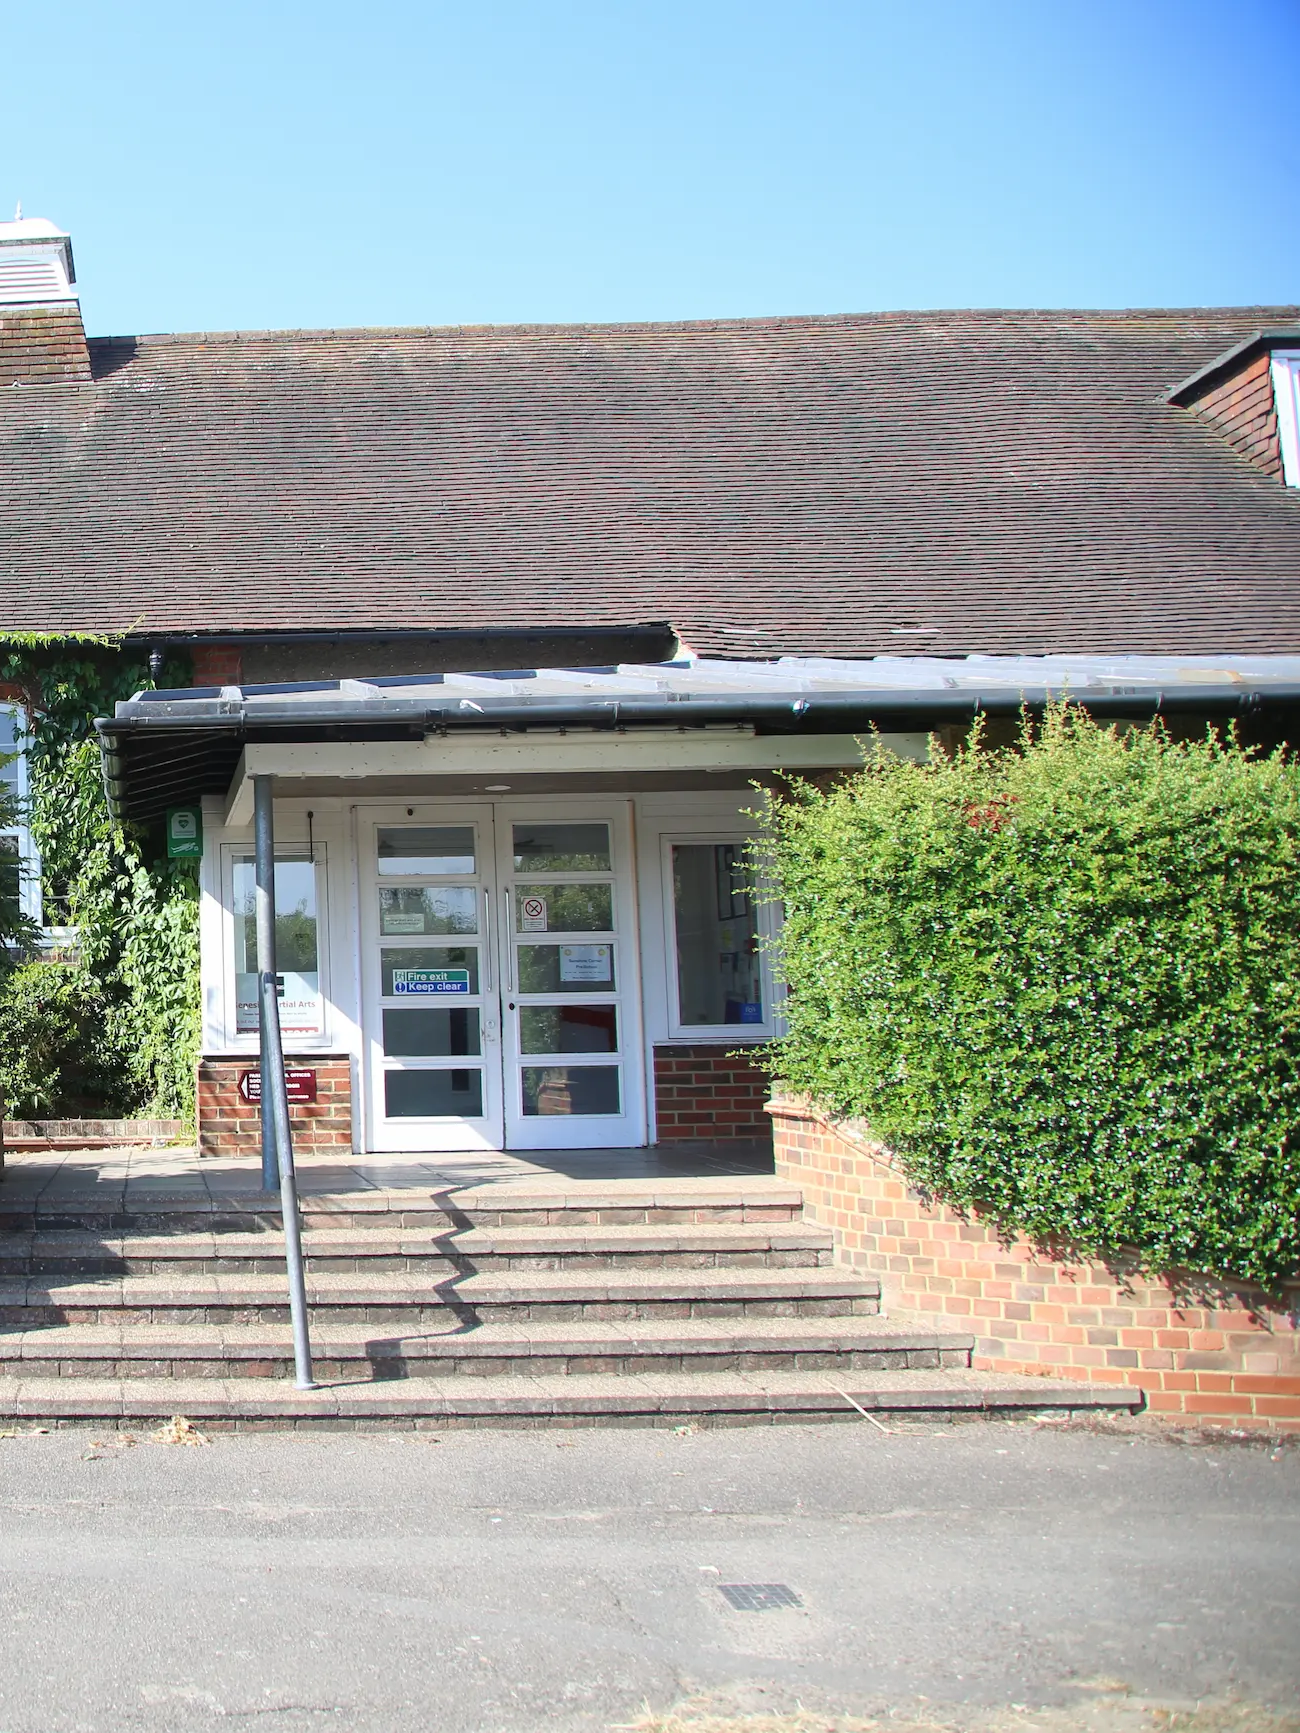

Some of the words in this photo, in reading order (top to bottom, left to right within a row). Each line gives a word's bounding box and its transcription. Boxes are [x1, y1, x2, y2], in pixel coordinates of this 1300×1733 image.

[407, 972, 427, 981] Fire
[429, 972, 448, 981] exit
[408, 982, 435, 992] Keep
[436, 982, 462, 991] clear
